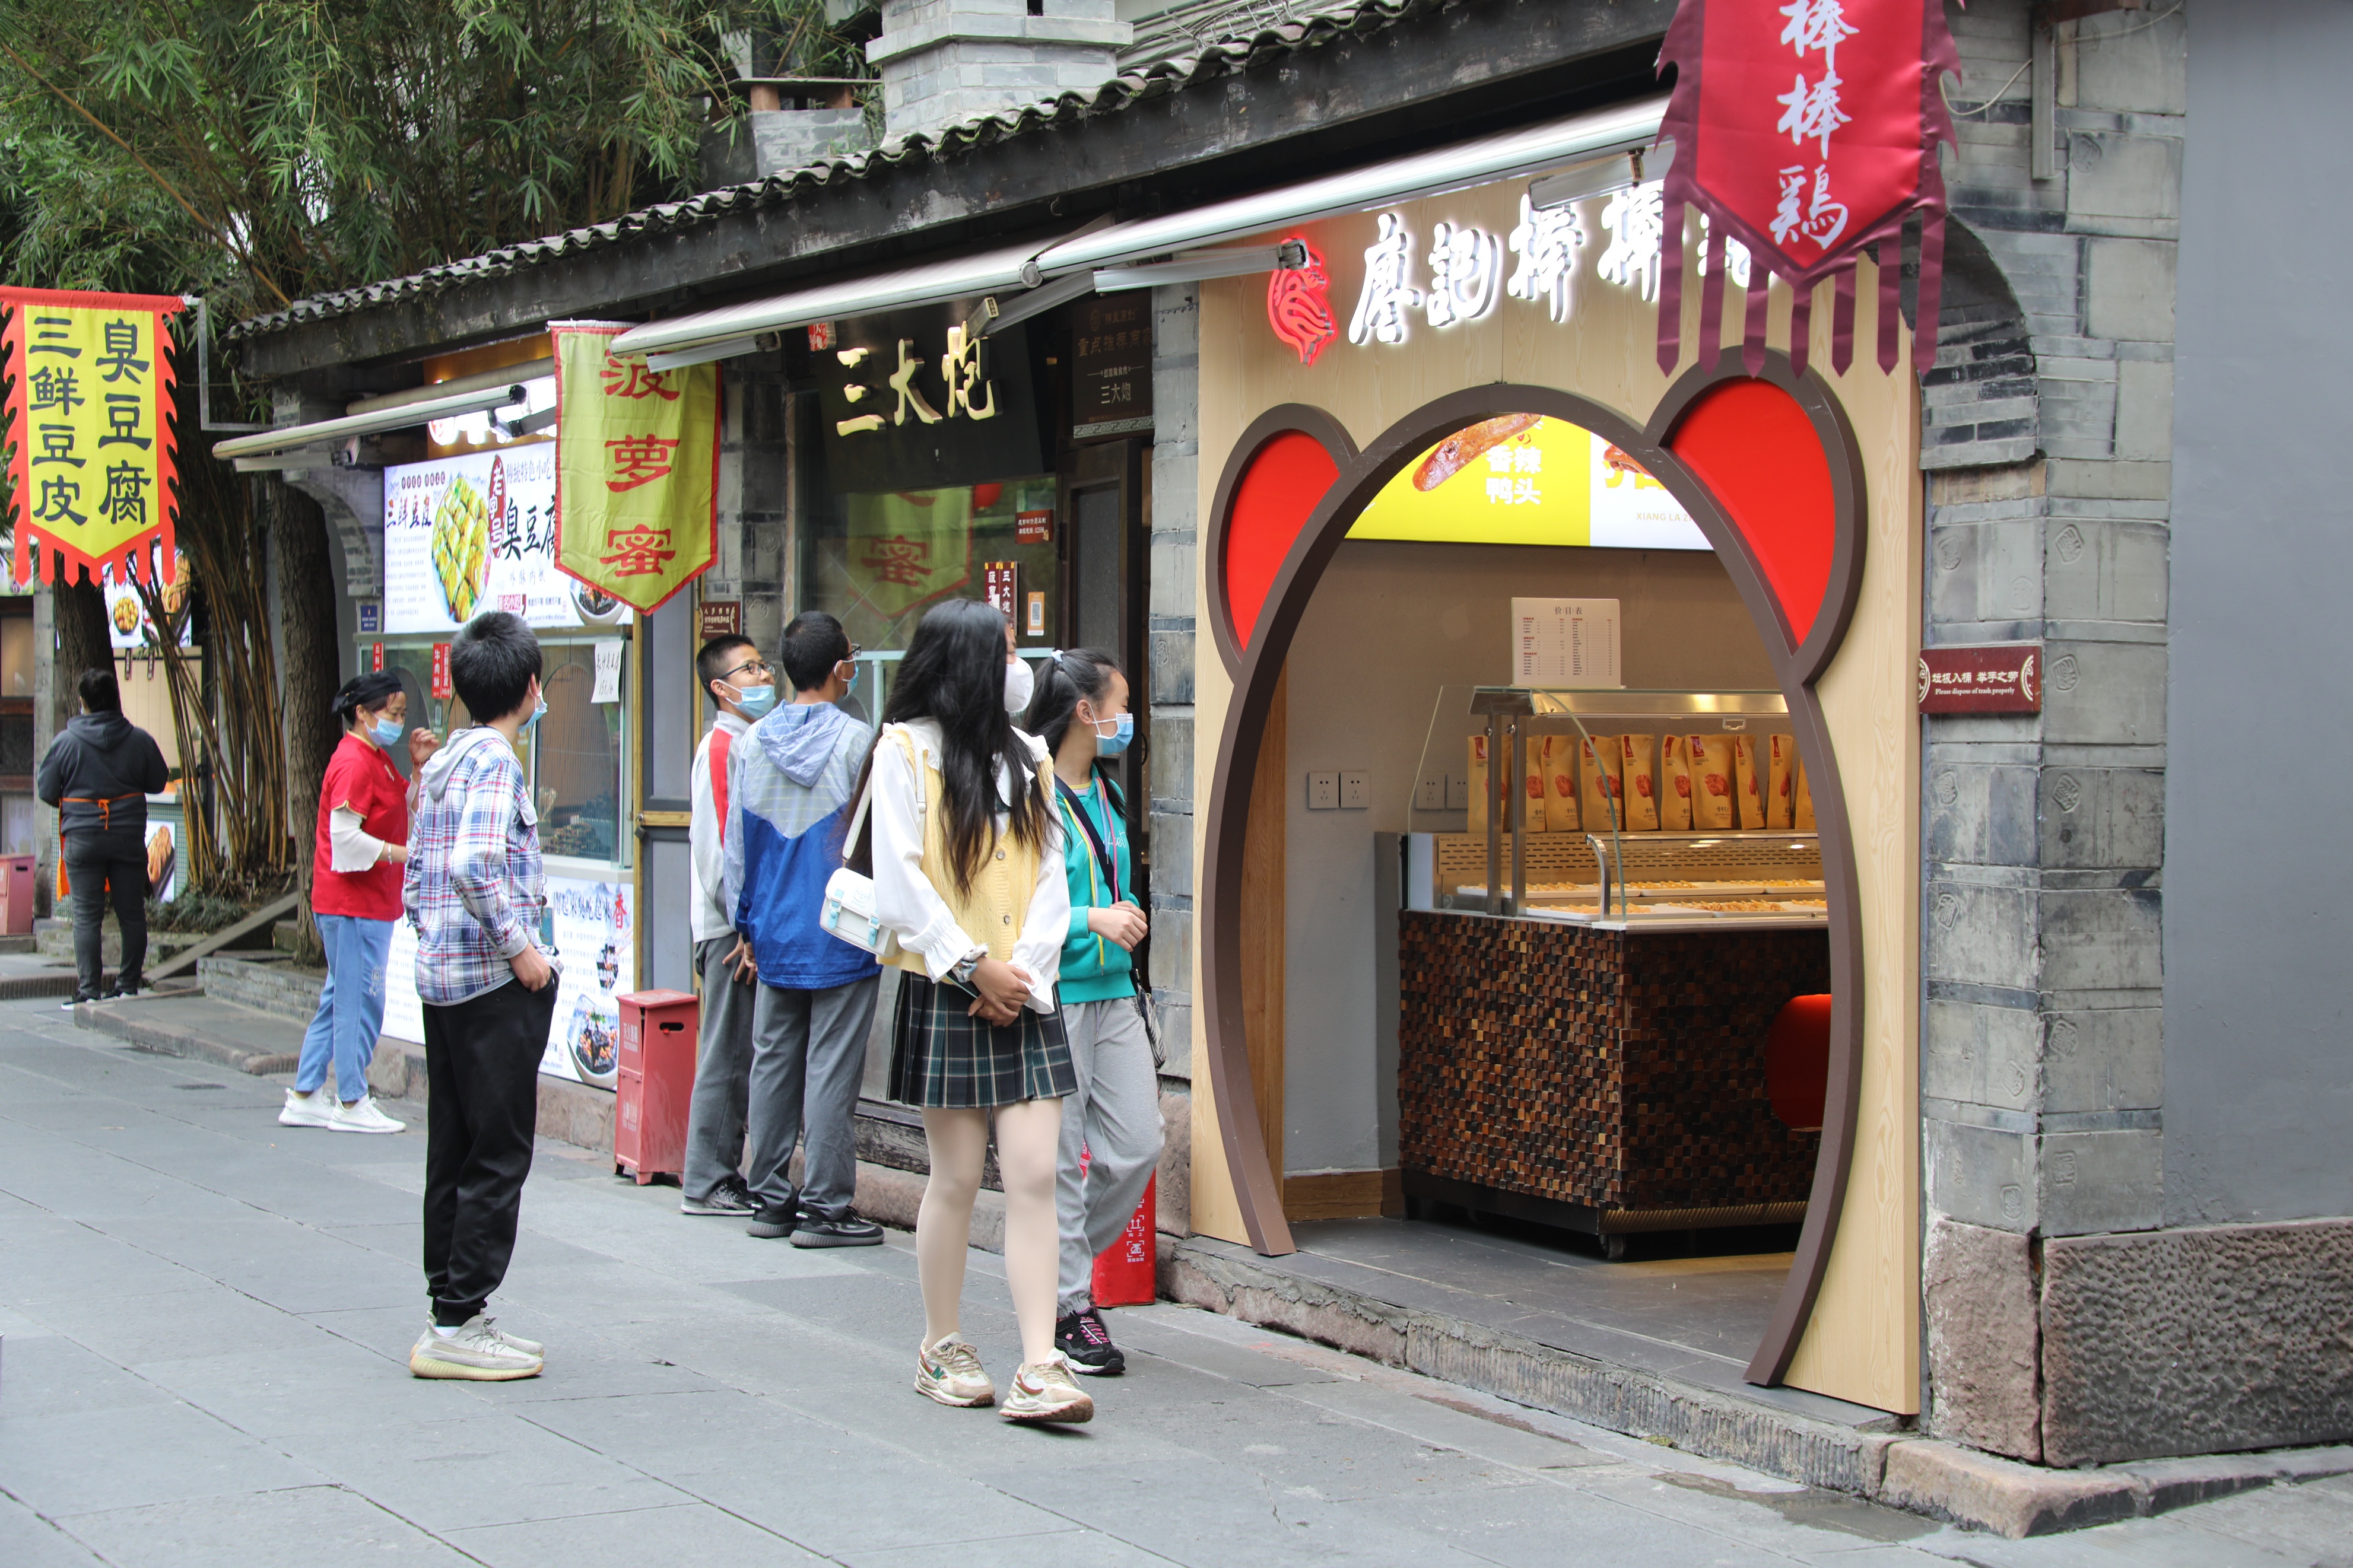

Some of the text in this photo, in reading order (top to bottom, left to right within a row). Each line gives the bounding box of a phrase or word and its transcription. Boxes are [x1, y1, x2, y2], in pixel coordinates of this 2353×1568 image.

[1348, 187, 1777, 346] 廖記棒棒
[1078, 327, 1152, 357] 重点推荐商家
[836, 320, 1001, 437] 三大炮
[1101, 383, 1131, 403] 三大炮
[28, 317, 88, 526] 三鲜豆皮
[96, 318, 153, 526] 臭豆腐
[1485, 446, 1541, 475] 香辣
[488, 463, 503, 549] 老字号
[1486, 478, 1541, 504] 鸭头
[1636, 512, 1666, 521] XIANG
[1669, 514, 1681, 522] LA
[988, 571, 997, 606] 菠萝
[1002, 570, 1011, 613] 三大炮
[1555, 606, 1583, 615] 价目表
[1932, 671, 2019, 683] 垃圾入桶 举手之劳
[1992, 687, 2015, 695] properly
